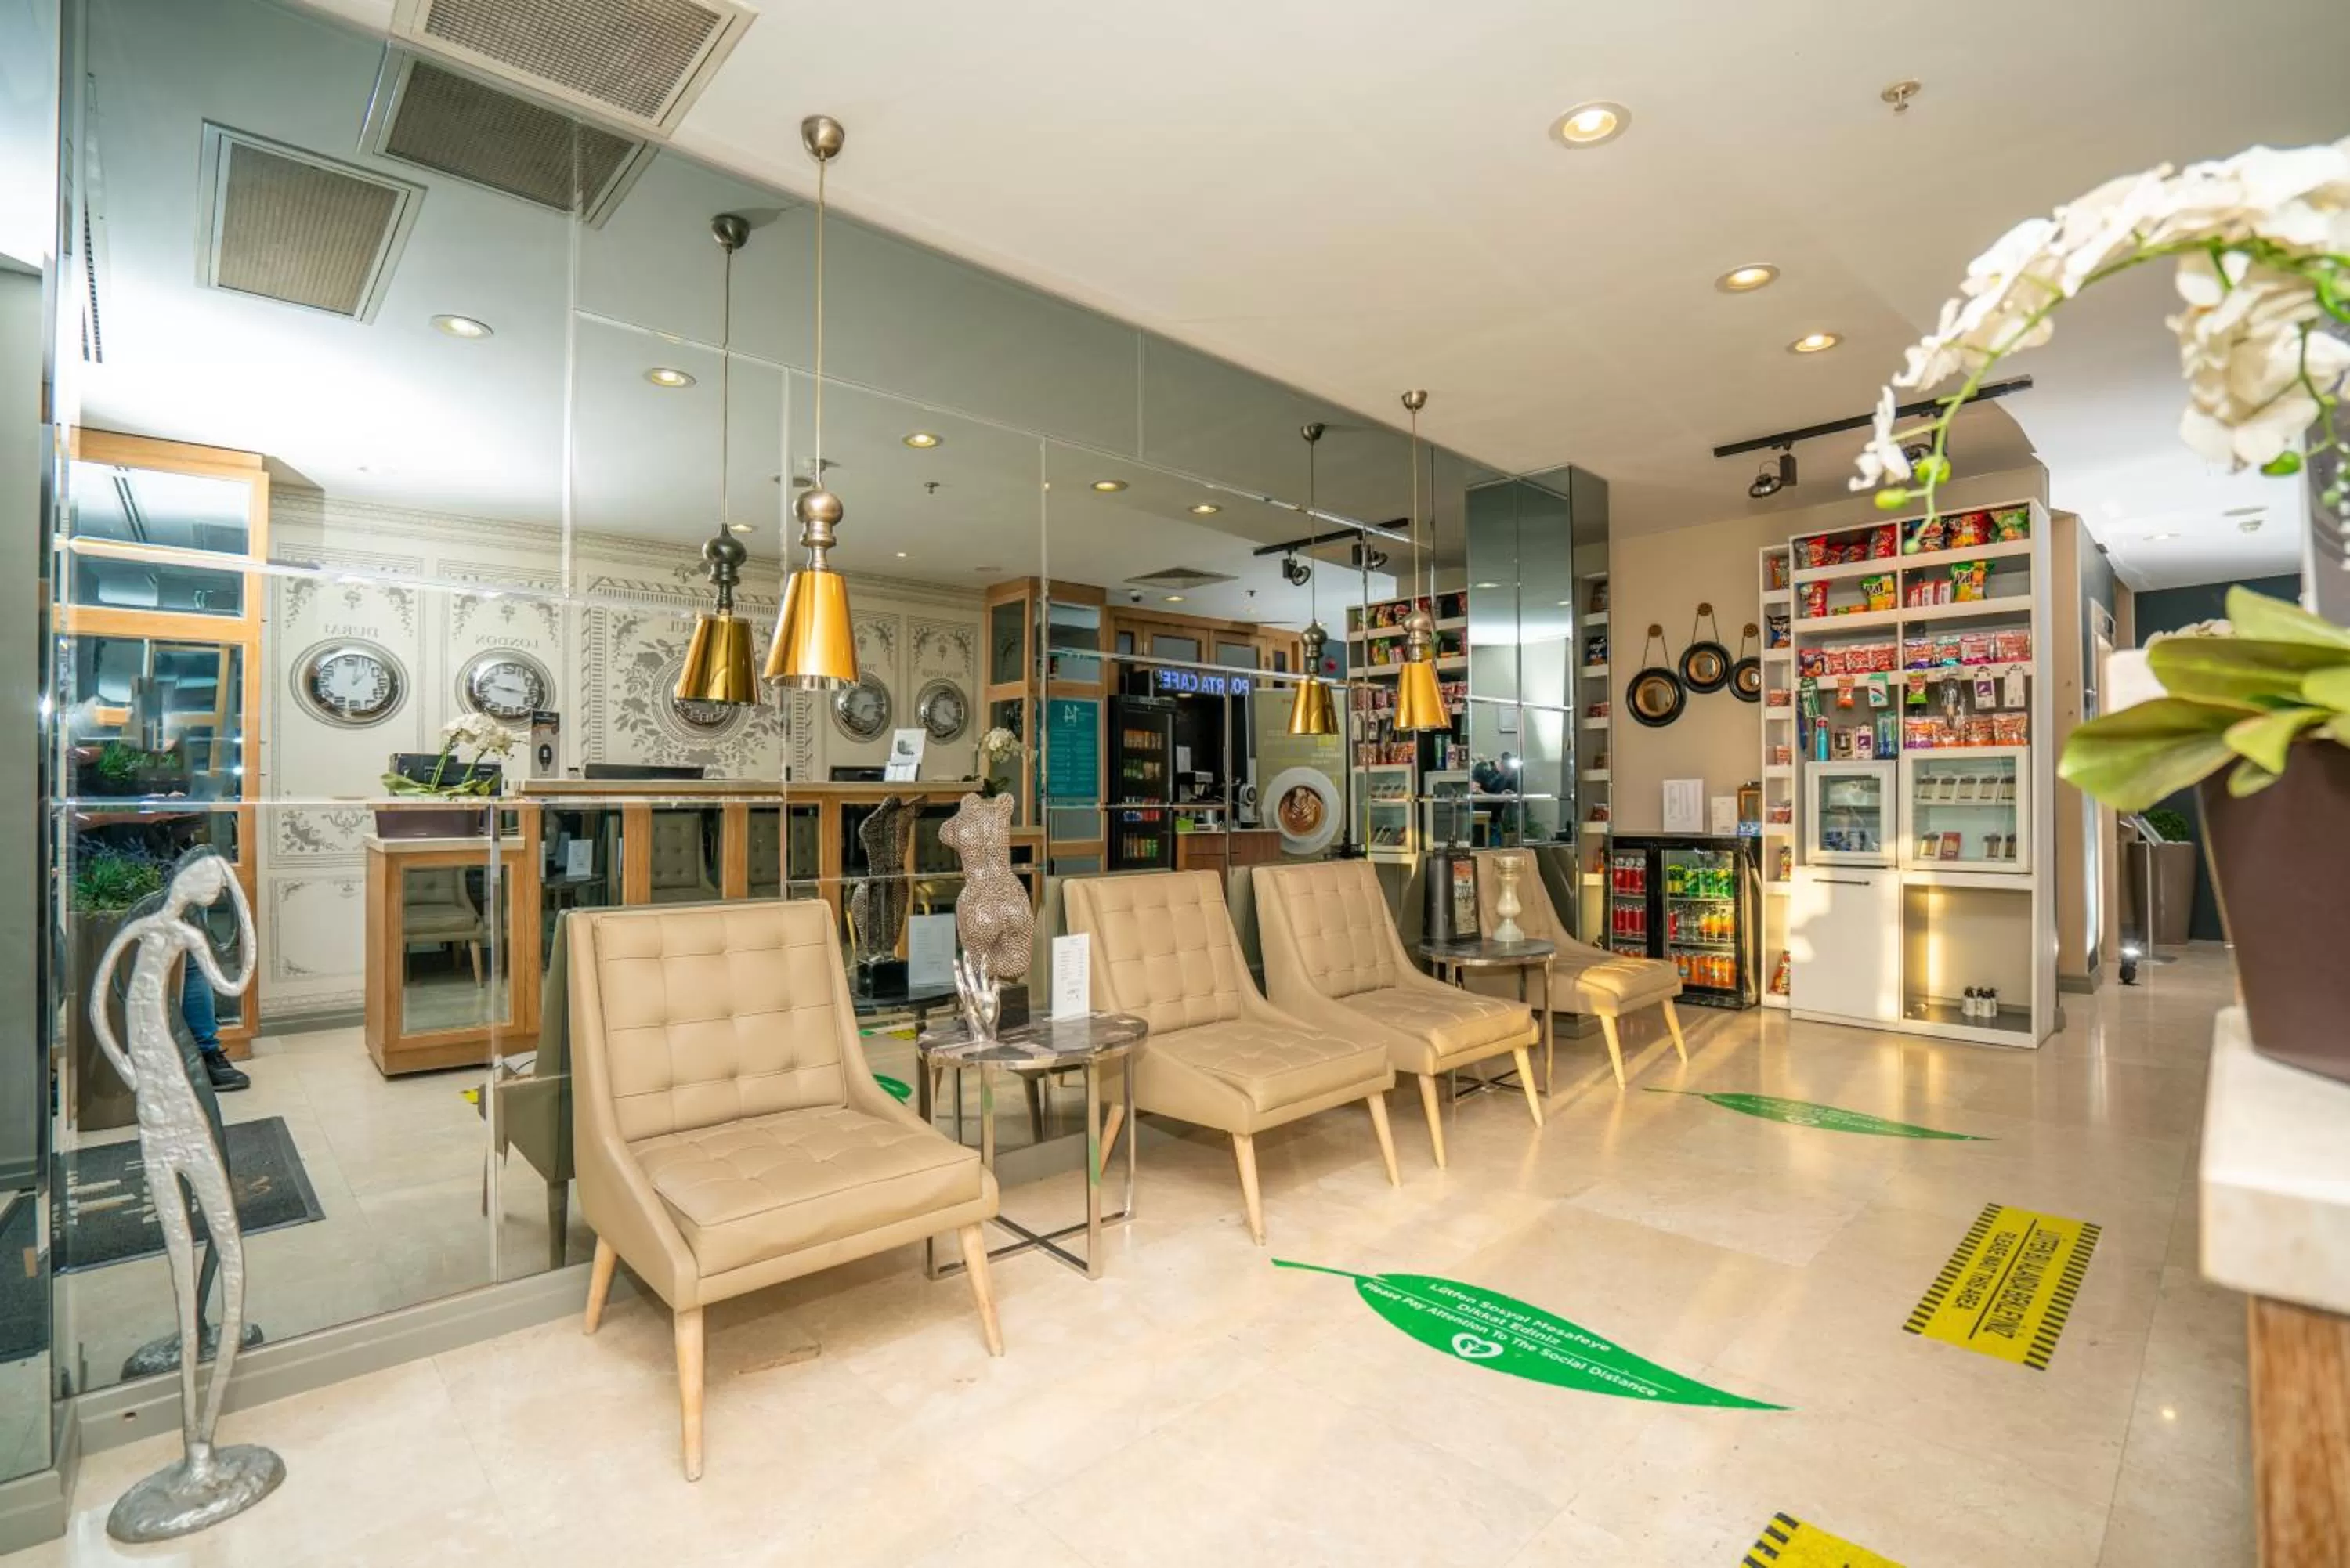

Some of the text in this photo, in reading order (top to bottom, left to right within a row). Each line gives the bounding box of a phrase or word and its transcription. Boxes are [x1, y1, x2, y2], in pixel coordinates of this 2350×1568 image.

[1363, 1282, 1658, 1397] Please Pay Attention To The Social Distance
[1456, 1303, 1561, 1345] Dikkat Ediniz
[1480, 1301, 1531, 1323] Sosyal
[1532, 1320, 1612, 1351] Mesafeye
